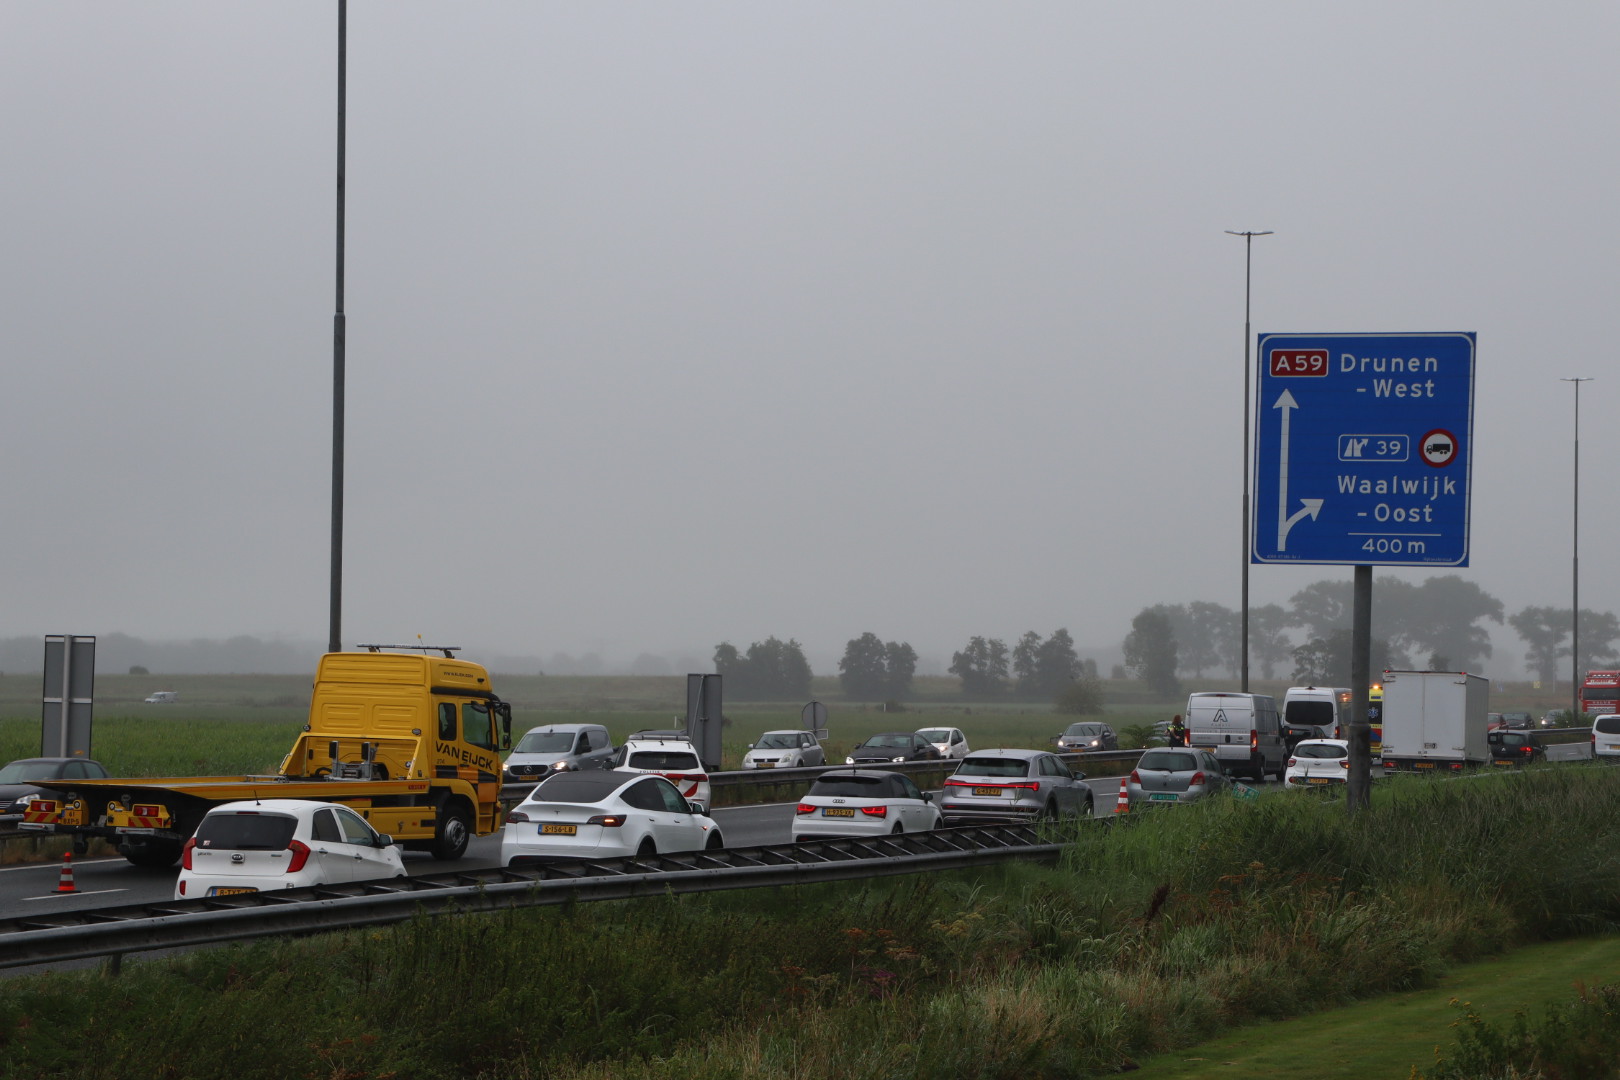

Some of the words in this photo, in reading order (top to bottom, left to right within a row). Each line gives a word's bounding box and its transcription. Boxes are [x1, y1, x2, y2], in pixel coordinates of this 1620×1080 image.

[1275, 355, 1323, 371] A59
[1341, 353, 1438, 373] Drunen
[1375, 441, 1401, 455] 39
[1337, 475, 1456, 500] Waalwijk
[1362, 539, 1402, 553] 400
[1407, 540, 1426, 553] m
[435, 740, 460, 759] VAN
[461, 749, 493, 771] EIJCK
